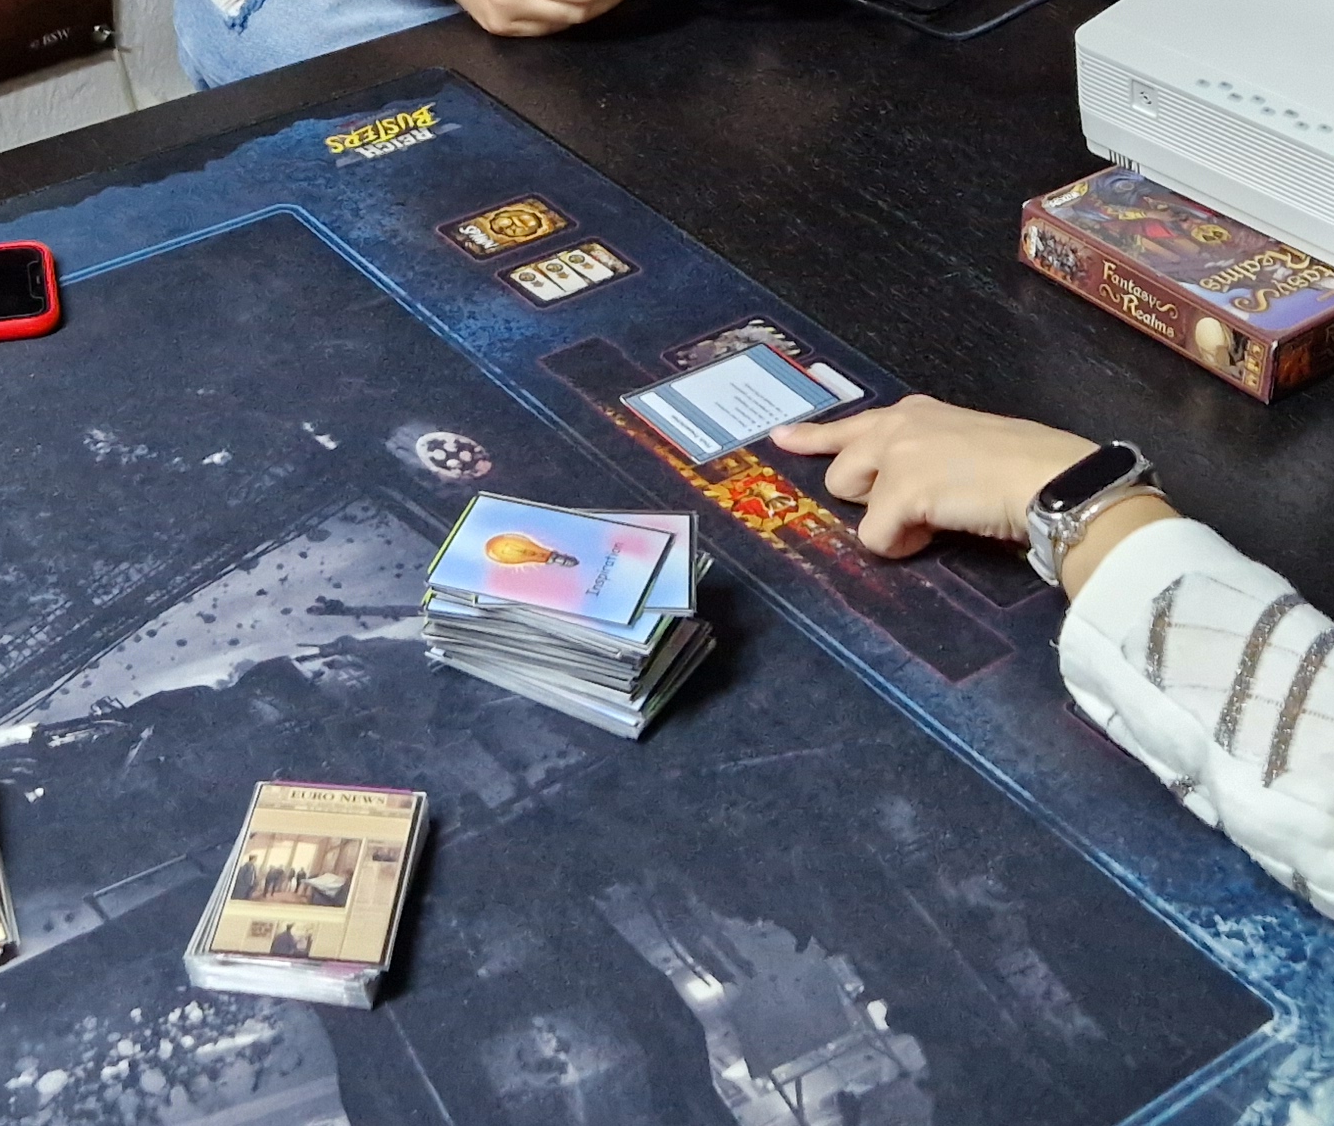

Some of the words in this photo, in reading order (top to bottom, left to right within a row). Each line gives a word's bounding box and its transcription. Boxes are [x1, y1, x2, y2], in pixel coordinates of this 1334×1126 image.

[325, 102, 441, 154] BUSTERS
[354, 127, 436, 159] REICH
[1102, 259, 1157, 308] Fantasy
[1121, 293, 1175, 338] Realms
[585, 541, 623, 597] Inspiration
[290, 789, 335, 801] EURO
[340, 792, 386, 805] NEWS
